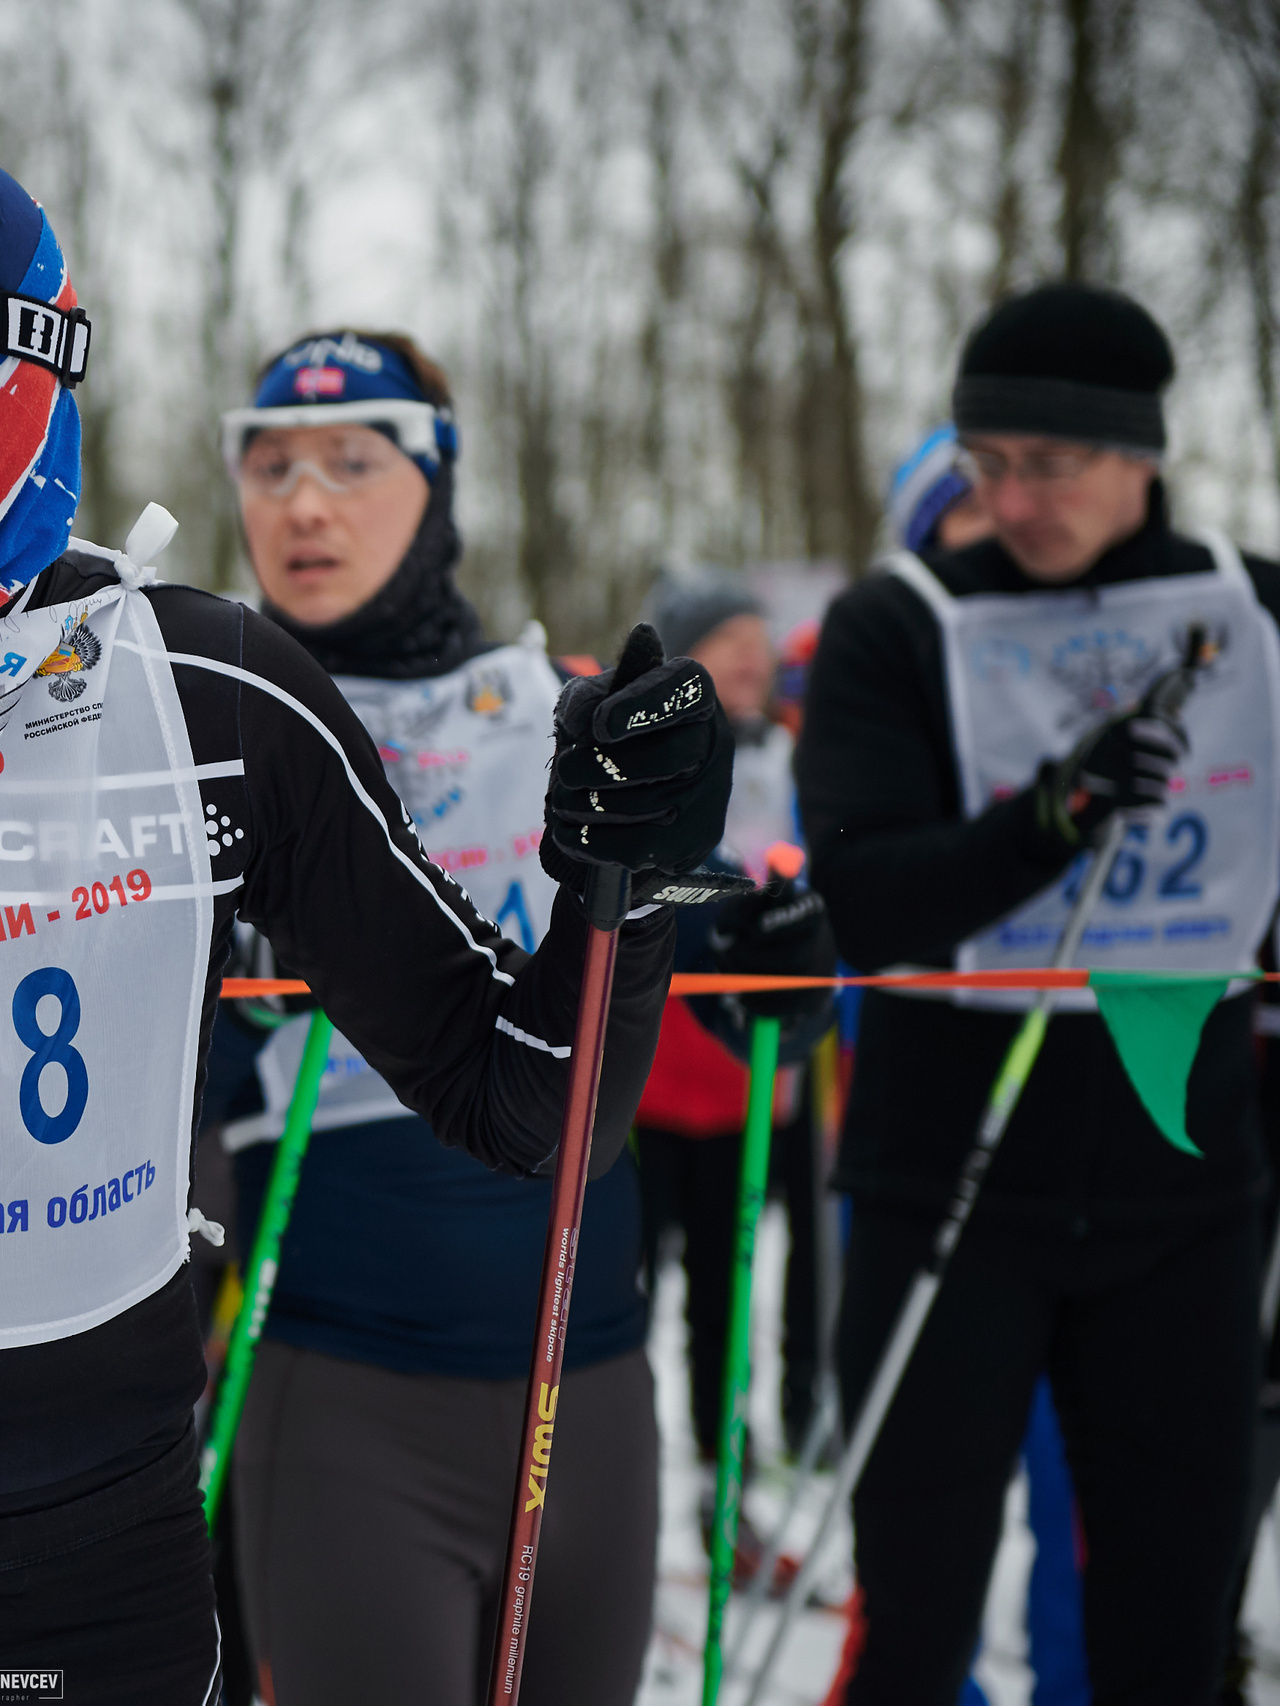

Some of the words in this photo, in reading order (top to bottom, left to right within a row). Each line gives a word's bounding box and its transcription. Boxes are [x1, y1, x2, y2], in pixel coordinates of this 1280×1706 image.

[24, 717, 80, 740] РОССИЙСКОЙ
[25, 705, 91, 729] МИНИСТЕРСТВО
[71, 868, 152, 922] 2019
[46, 1159, 156, 1229] область
[558, 1228, 569, 1268] worlds
[551, 1271, 565, 1316] lightest
[545, 1319, 558, 1362] skipole
[524, 1382, 560, 1513] SWIX
[511, 1586, 526, 1635] graphite
[504, 1637, 519, 1695] millenium
